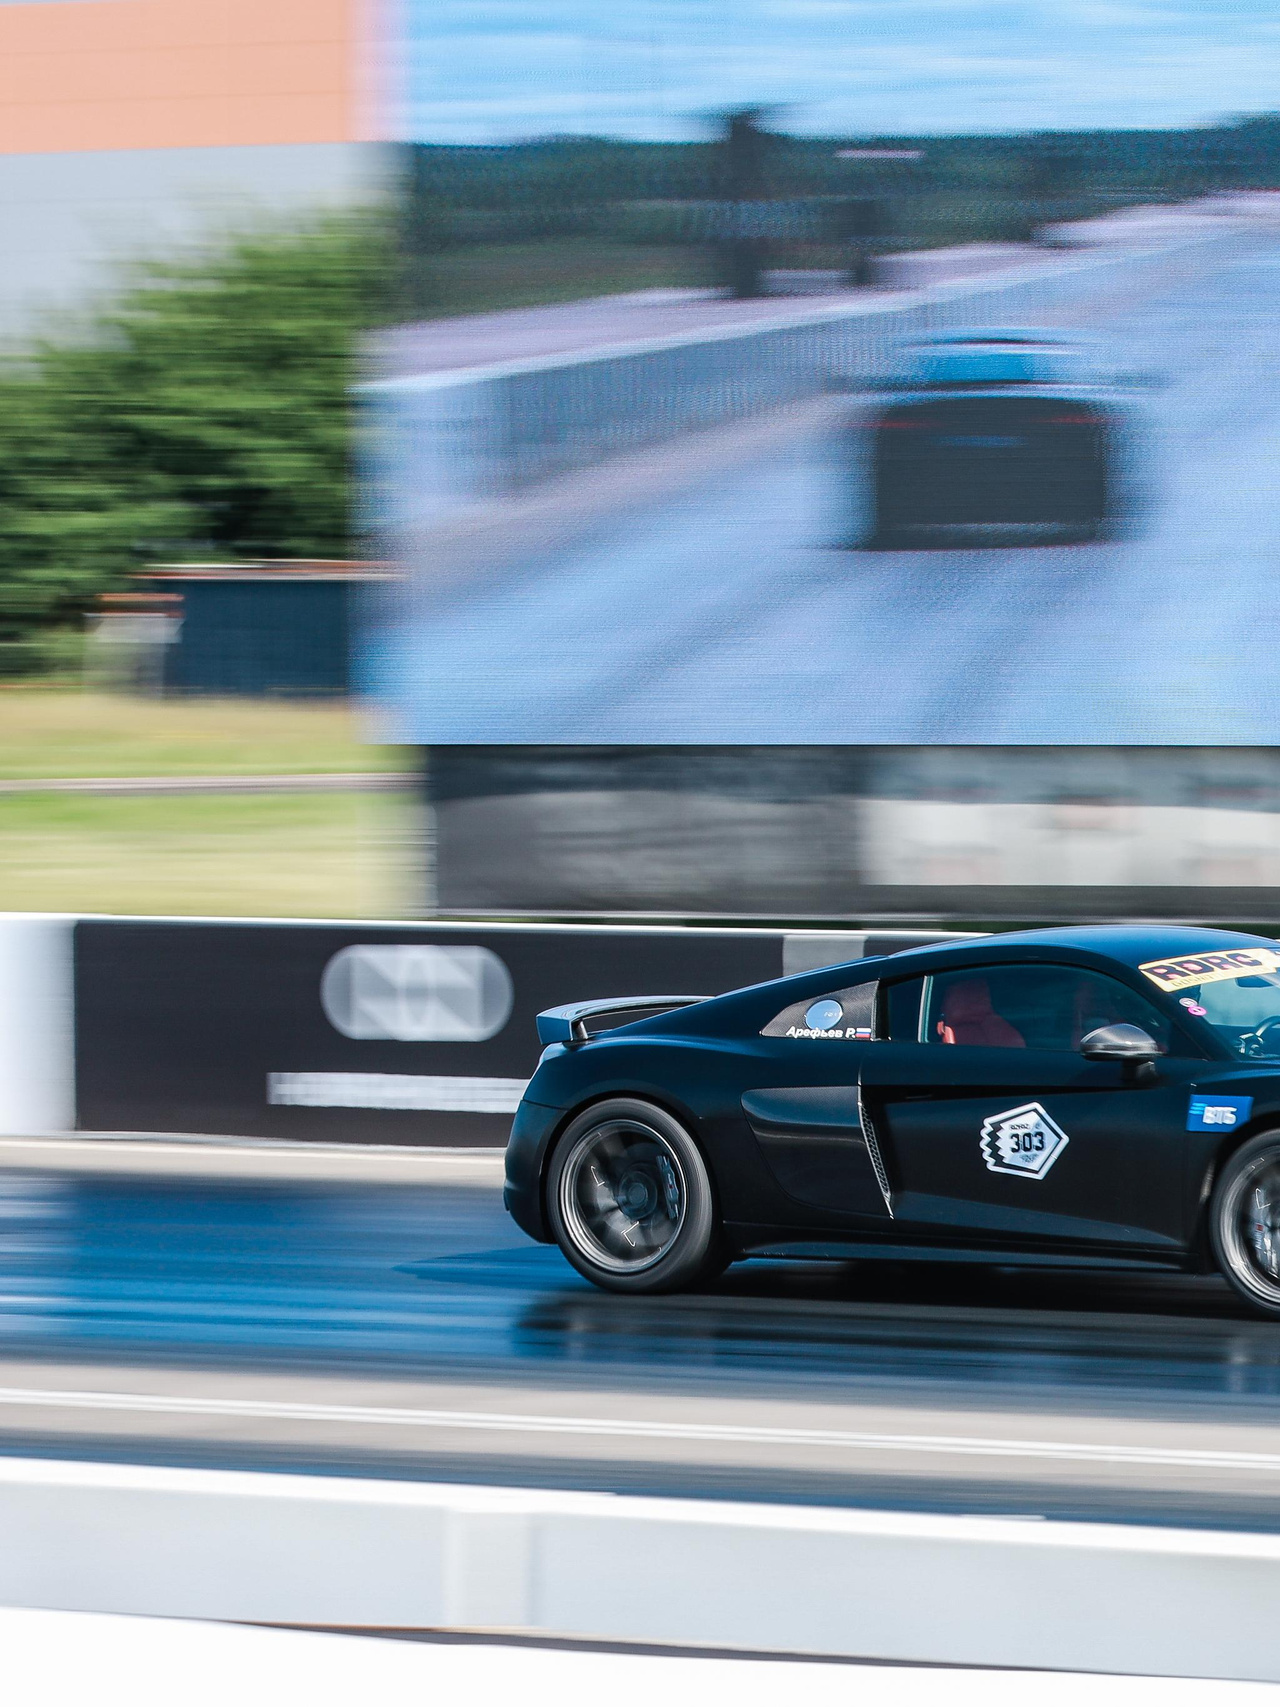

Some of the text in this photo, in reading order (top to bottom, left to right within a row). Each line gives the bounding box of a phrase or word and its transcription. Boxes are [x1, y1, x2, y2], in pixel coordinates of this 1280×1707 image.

[1142, 952, 1263, 981] RDRC
[786, 1025, 844, 1039] Арефьев
[1010, 1131, 1045, 1153] 303
